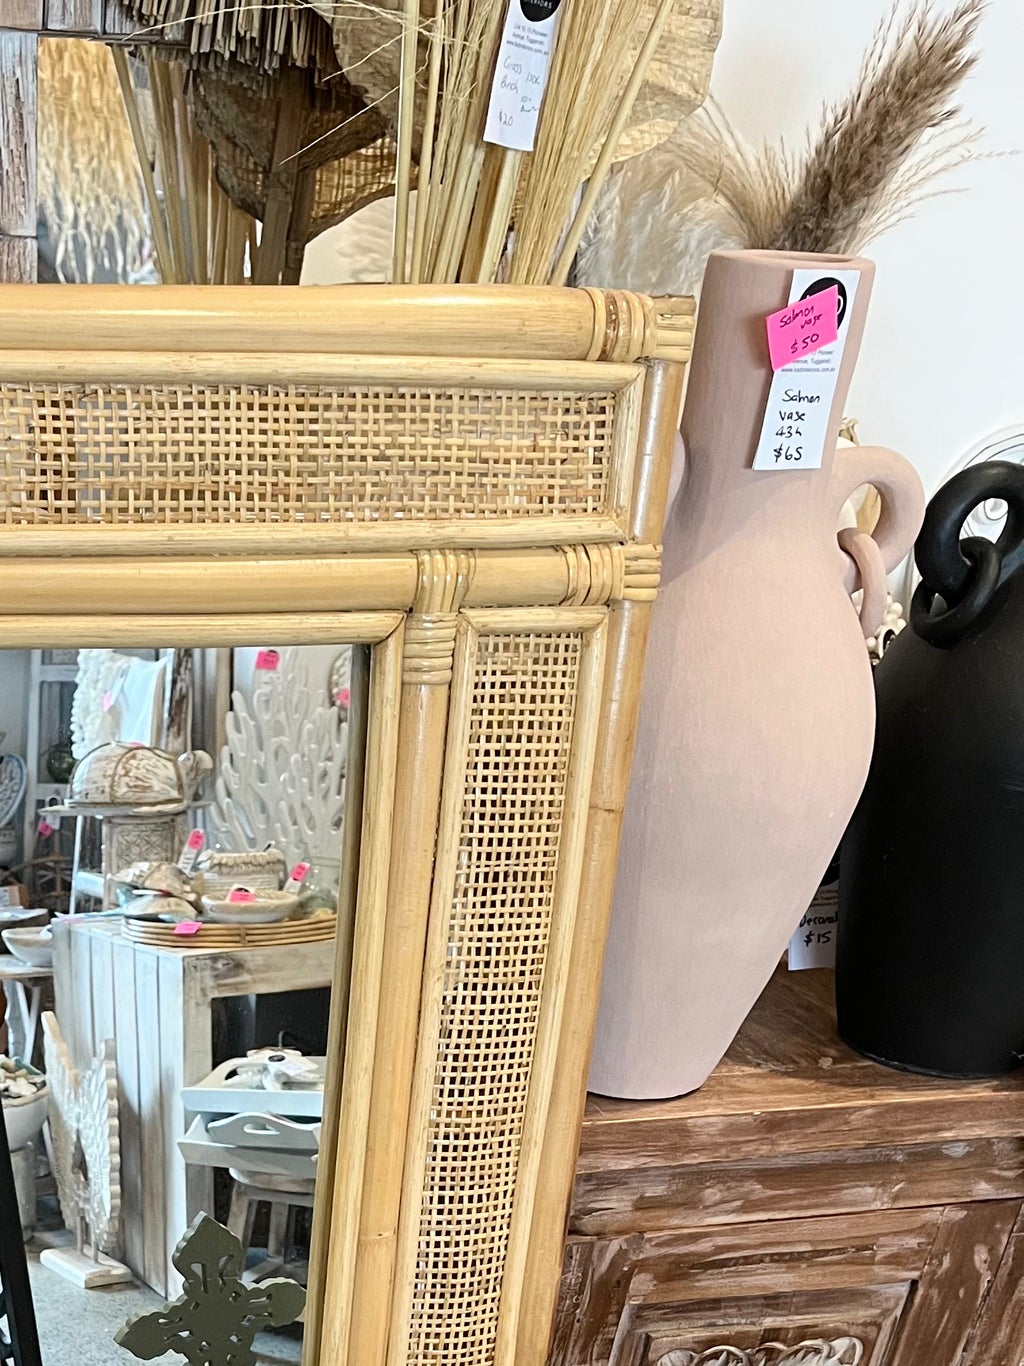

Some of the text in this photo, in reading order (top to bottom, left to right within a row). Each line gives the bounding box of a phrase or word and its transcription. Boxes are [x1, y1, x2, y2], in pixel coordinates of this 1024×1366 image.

[779, 305, 815, 328] Salmon
[800, 313, 823, 330] vase
[790, 333, 820, 354] $50
[782, 389, 821, 404] Salmon
[773, 442, 804, 463] $65
[804, 930, 832, 948] $15
